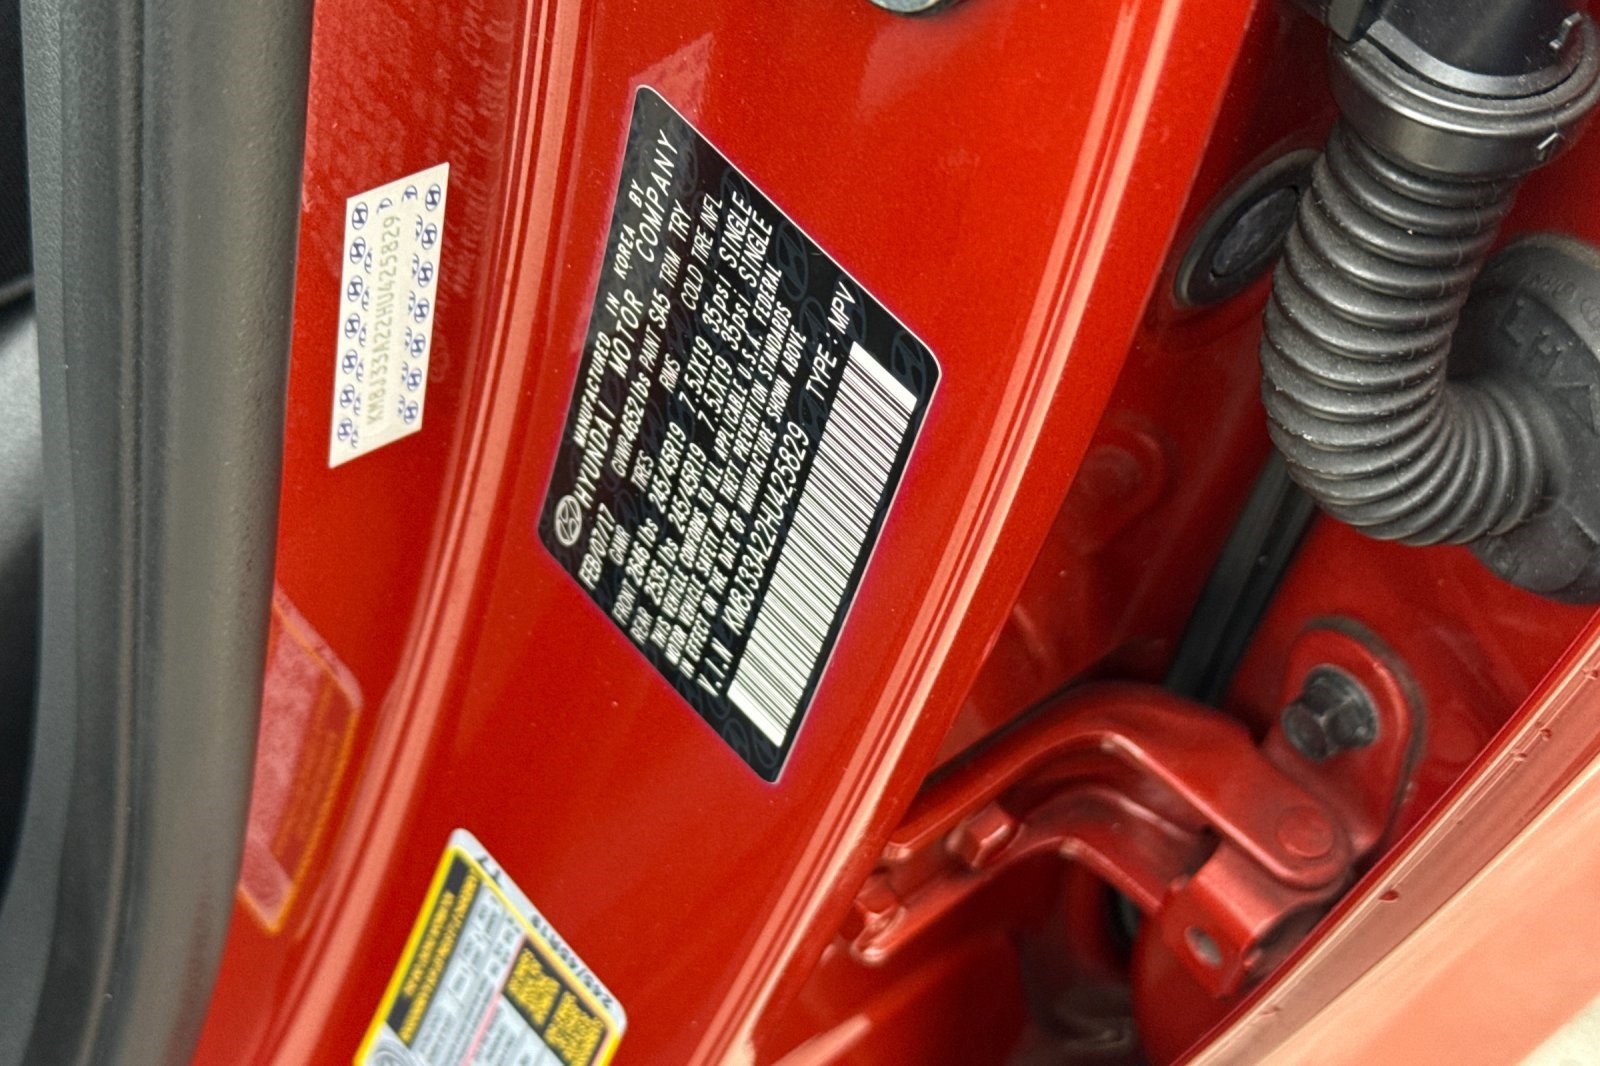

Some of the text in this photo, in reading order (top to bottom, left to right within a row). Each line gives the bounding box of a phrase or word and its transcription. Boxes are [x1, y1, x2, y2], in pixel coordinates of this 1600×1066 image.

[367, 216, 400, 424] KM8J33A22HU425829
[573, 178, 645, 447] MANUFACTURED IN KOREA BY
[574, 129, 677, 508] HYUNDAI MOTOR COMPANY
[608, 193, 723, 565] GAWR TIRES RIMS COLD TIRE INFL
[638, 324, 661, 372] PAINT
[647, 287, 671, 329] SA5
[658, 245, 681, 288] TRIM
[667, 198, 692, 242] TRY
[579, 502, 615, 589] FEB/07/17
[612, 578, 636, 624] FRONT
[648, 421, 686, 513] 245/45R19
[678, 335, 713, 413] 7.5JX19
[718, 191, 752, 268] SINGLE
[630, 606, 653, 644] REAR
[667, 442, 707, 534] 245/45R19
[697, 354, 733, 432] 7.5JX19
[738, 210, 773, 288] SINGLE
[650, 262, 782, 648] THIS VEHICLE CONFORMS TO ALL APPLICABLE U.S.A. FEDERAL
[665, 301, 792, 665] MOTOR VEHICLE SAFETY AND THEFT PREVENTION STANDARDS
[679, 324, 807, 678] IN EFFECT ON THE DATE OF MANUFACTURE SHOWN ABOVE
[722, 422, 808, 634] KM8J33A22HU425829
[805, 343, 837, 400] TYPE
[827, 281, 855, 334] MPV
